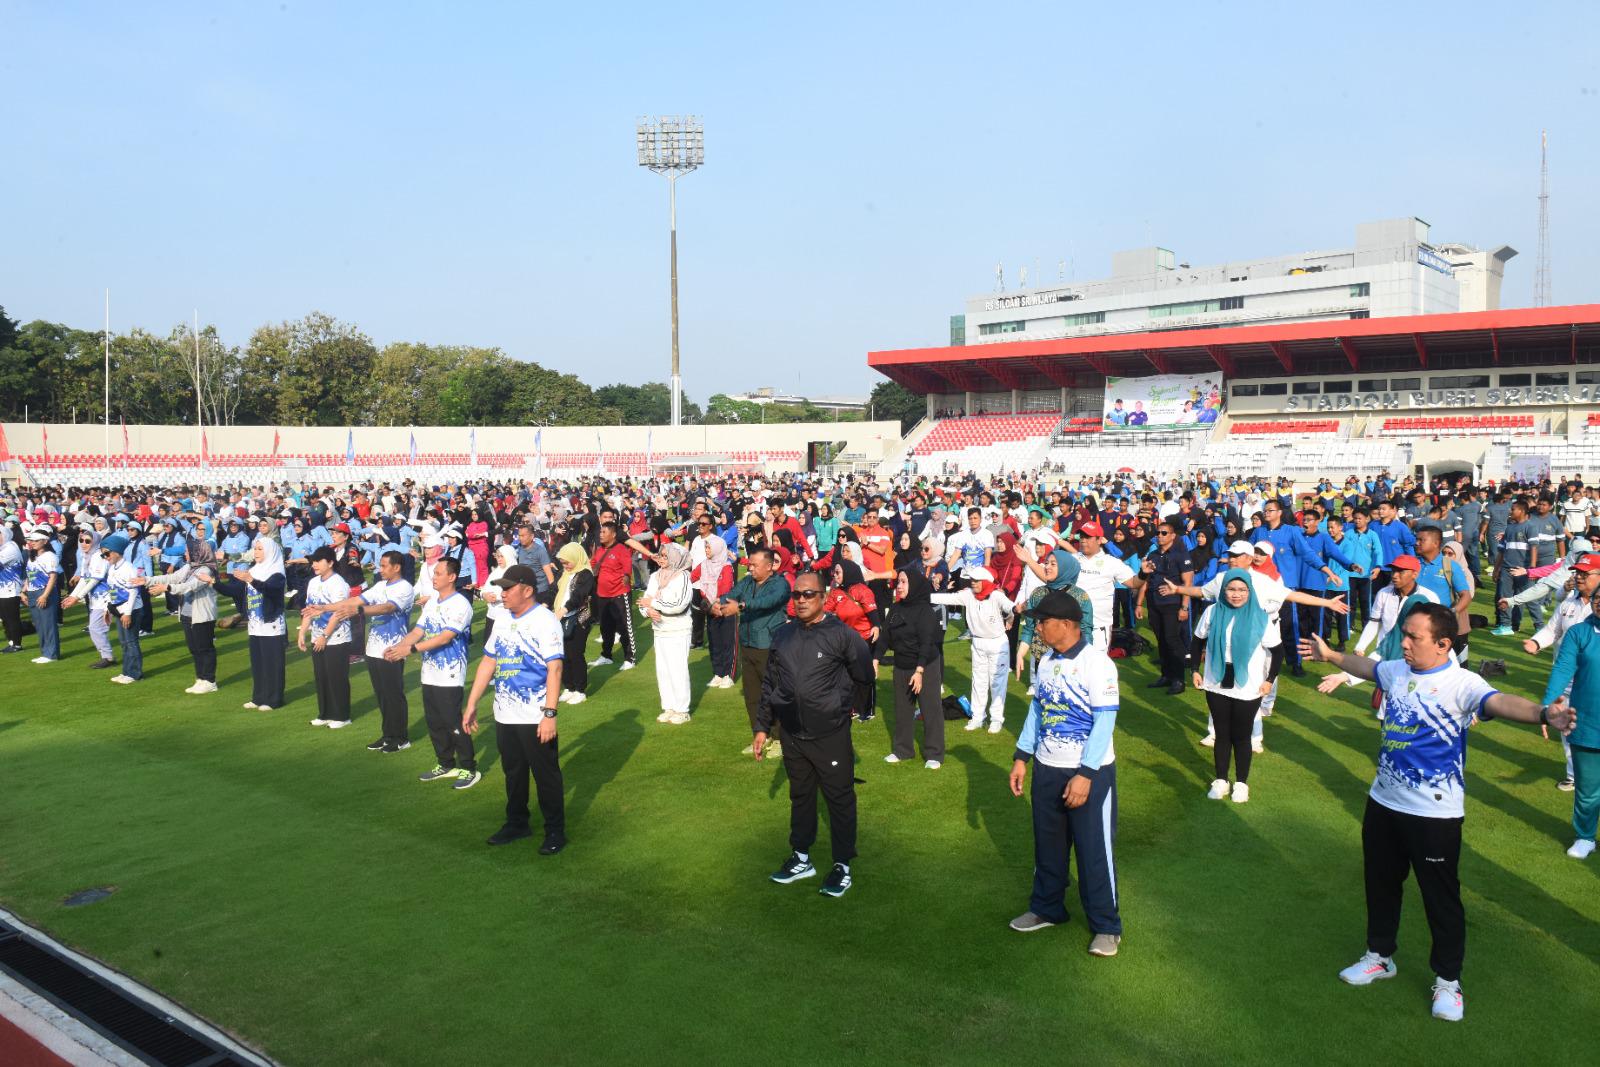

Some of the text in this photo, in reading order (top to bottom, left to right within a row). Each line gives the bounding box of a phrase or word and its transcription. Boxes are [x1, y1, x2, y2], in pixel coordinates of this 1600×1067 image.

[985, 302, 994, 311] RS
[1021, 294, 1057, 307] SRIWIJAYA
[1285, 392, 1399, 411] STADION
[1409, 389, 1476, 408] BUMI
